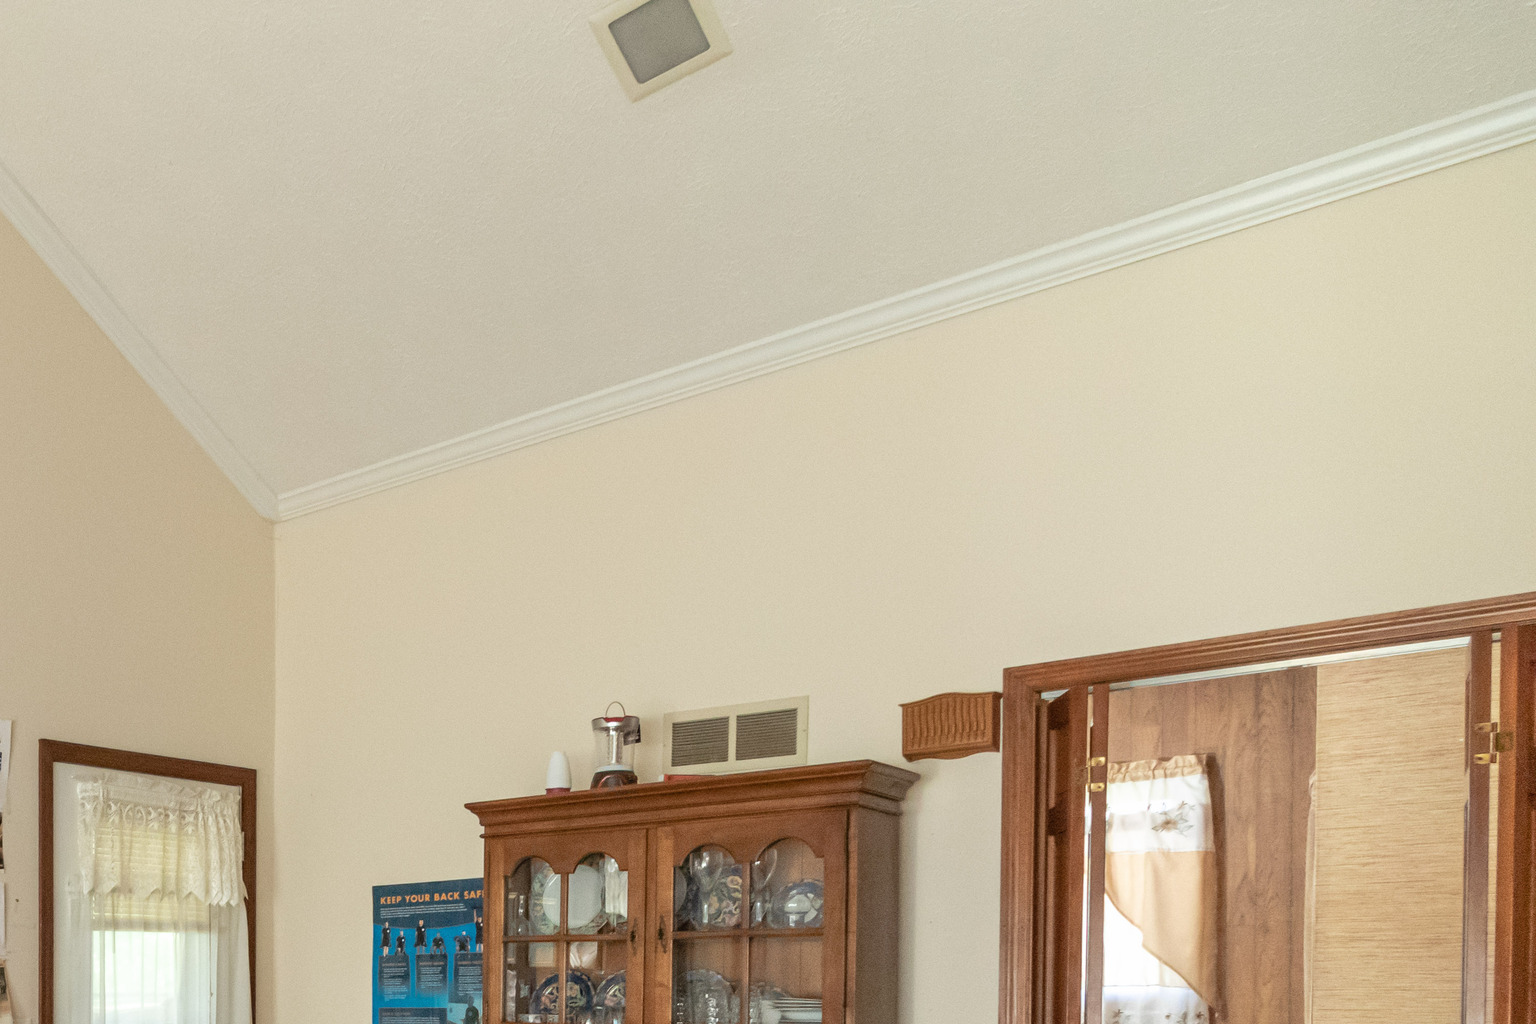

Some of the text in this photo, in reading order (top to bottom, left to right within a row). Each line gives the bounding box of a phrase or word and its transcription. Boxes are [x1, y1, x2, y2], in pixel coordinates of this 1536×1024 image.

[380, 895, 402, 904] KEEP
[405, 893, 430, 903] YOUR
[434, 891, 460, 901] BACK
